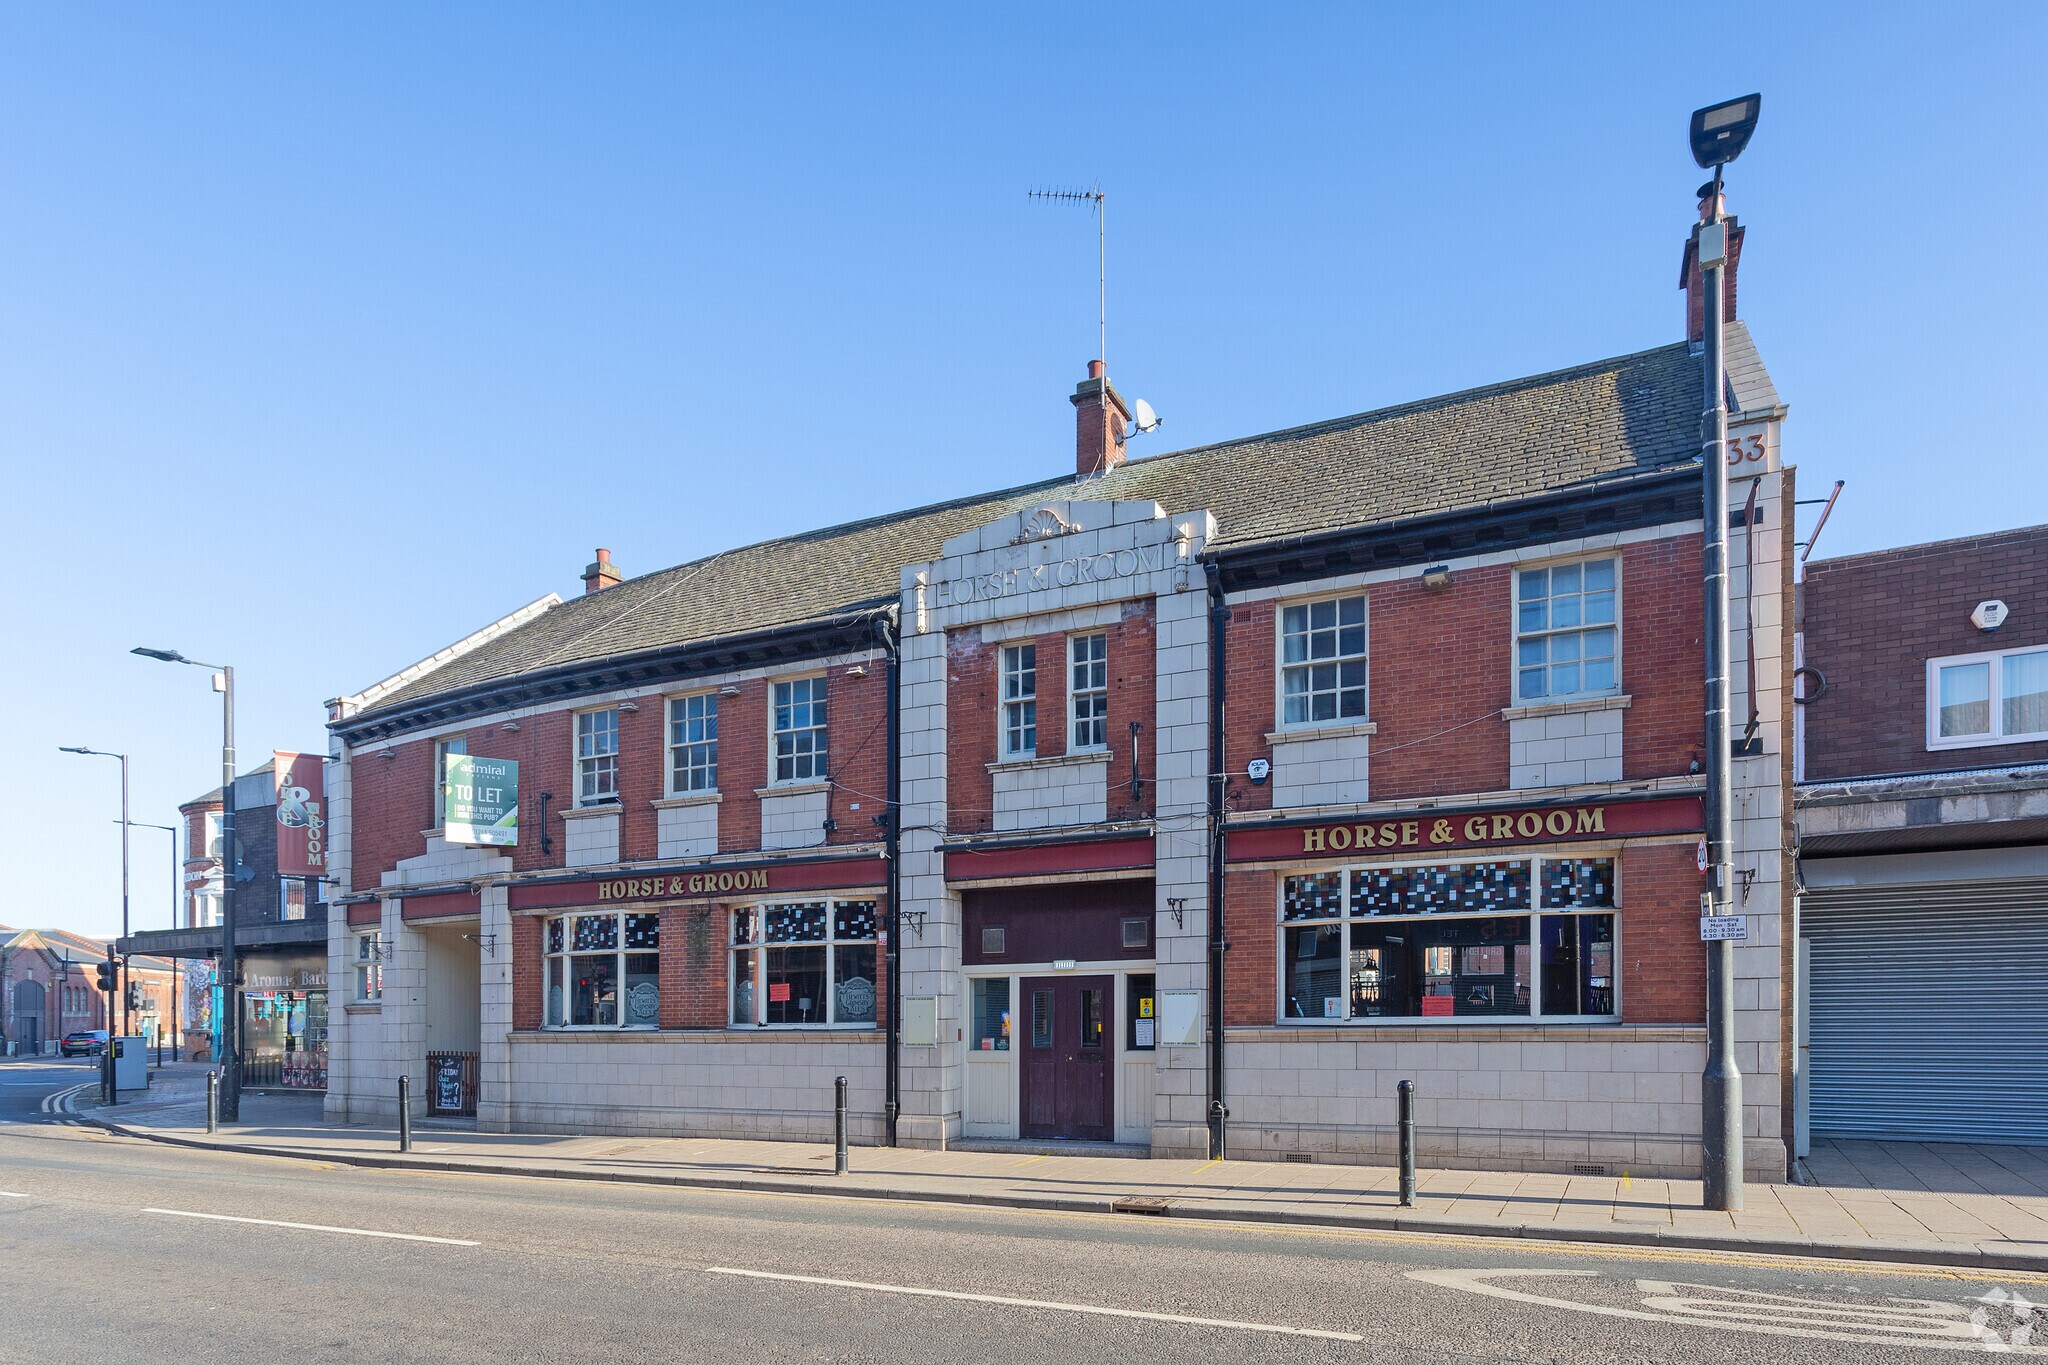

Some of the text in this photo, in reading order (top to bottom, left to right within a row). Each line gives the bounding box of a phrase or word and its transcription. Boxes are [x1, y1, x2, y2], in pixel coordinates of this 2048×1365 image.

[936, 544, 1165, 606] HORSE & GROOM
[460, 762, 506, 776] admiral
[455, 784, 503, 803] TO LET
[467, 805, 478, 813] YOU
[479, 806, 495, 814] WANT
[495, 807, 503, 815] TO
[470, 812, 483, 820] THIS
[483, 814, 499, 822] PUB?
[1302, 807, 1606, 853] HORSE & GROOM
[598, 869, 769, 899] HORSE & GROOM
[250, 973, 290, 987] Aroma
